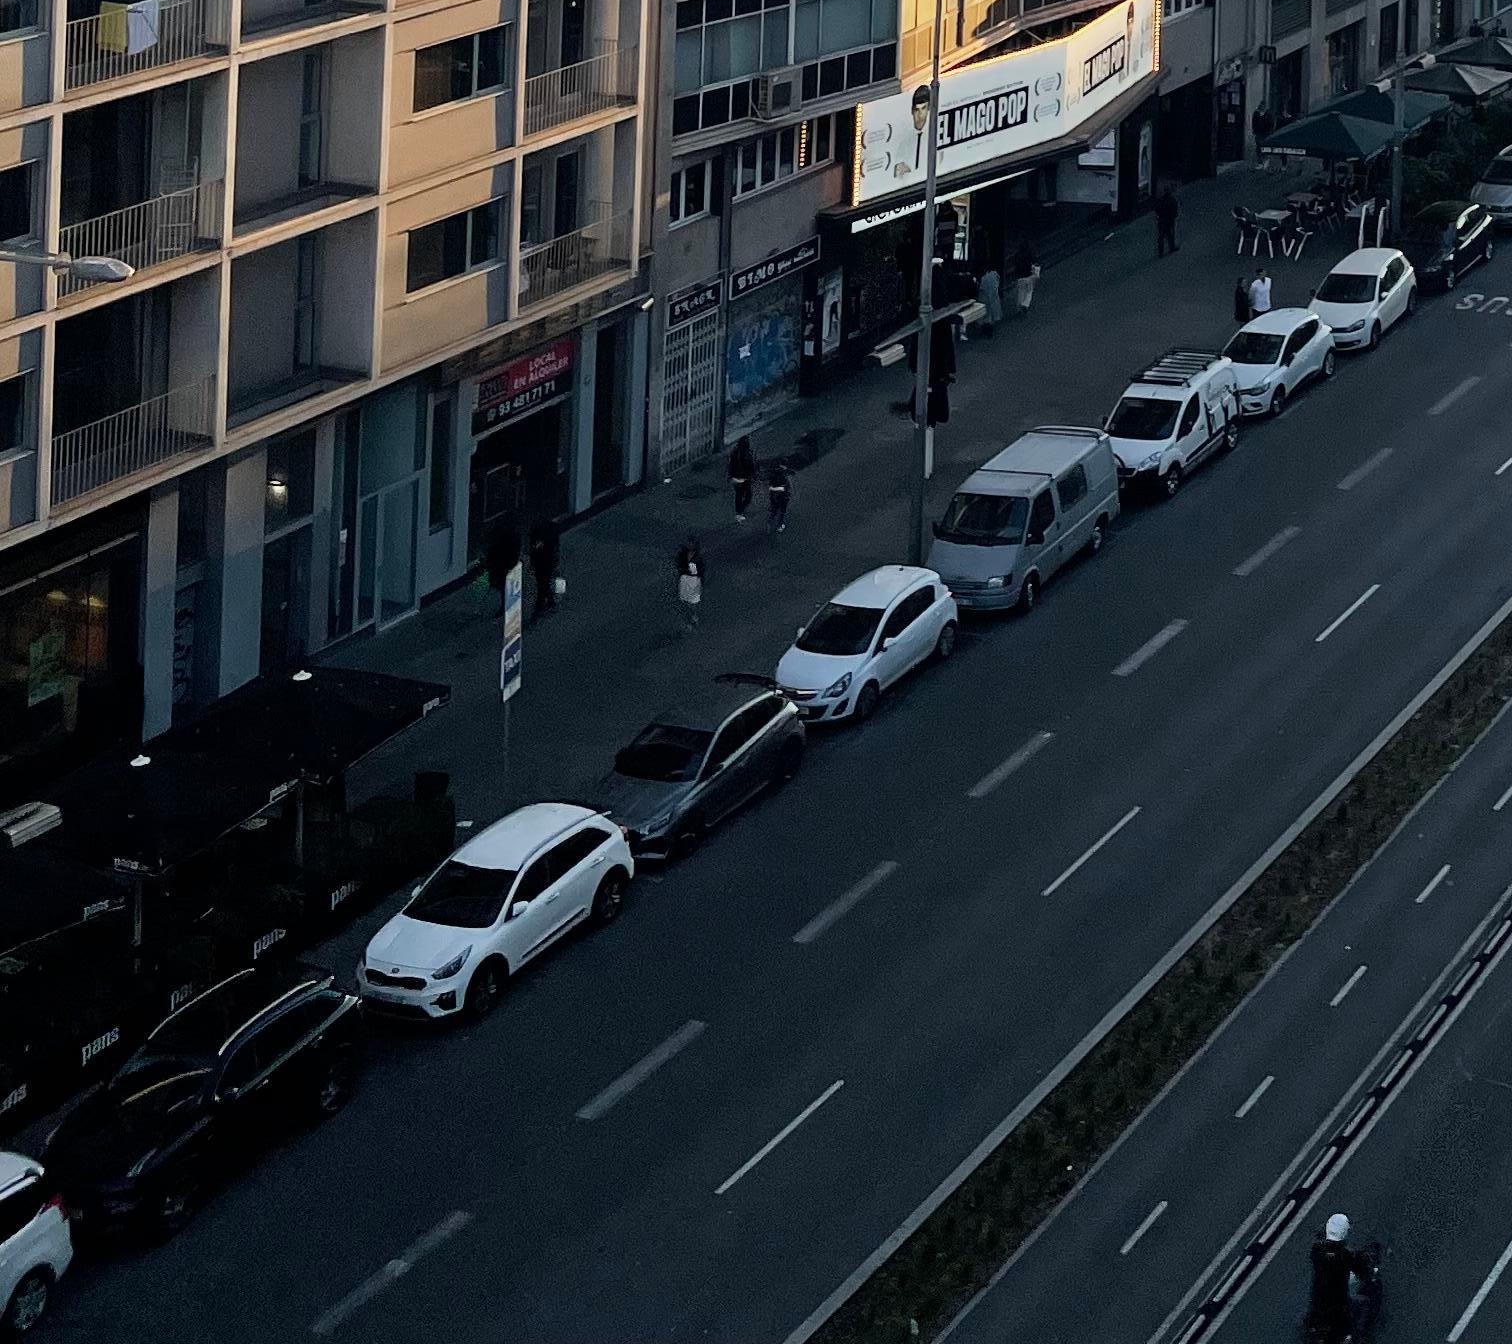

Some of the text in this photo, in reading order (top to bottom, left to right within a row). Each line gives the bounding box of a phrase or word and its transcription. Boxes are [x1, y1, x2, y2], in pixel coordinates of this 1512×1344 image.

[937, 112, 951, 148] EL
[953, 99, 997, 142] MAGO
[997, 89, 1027, 129] POP
[528, 351, 556, 372] LOCAL
[253, 928, 287, 960] pans
[81, 1027, 120, 1067] pans
[0, 1083, 28, 1113] ans
